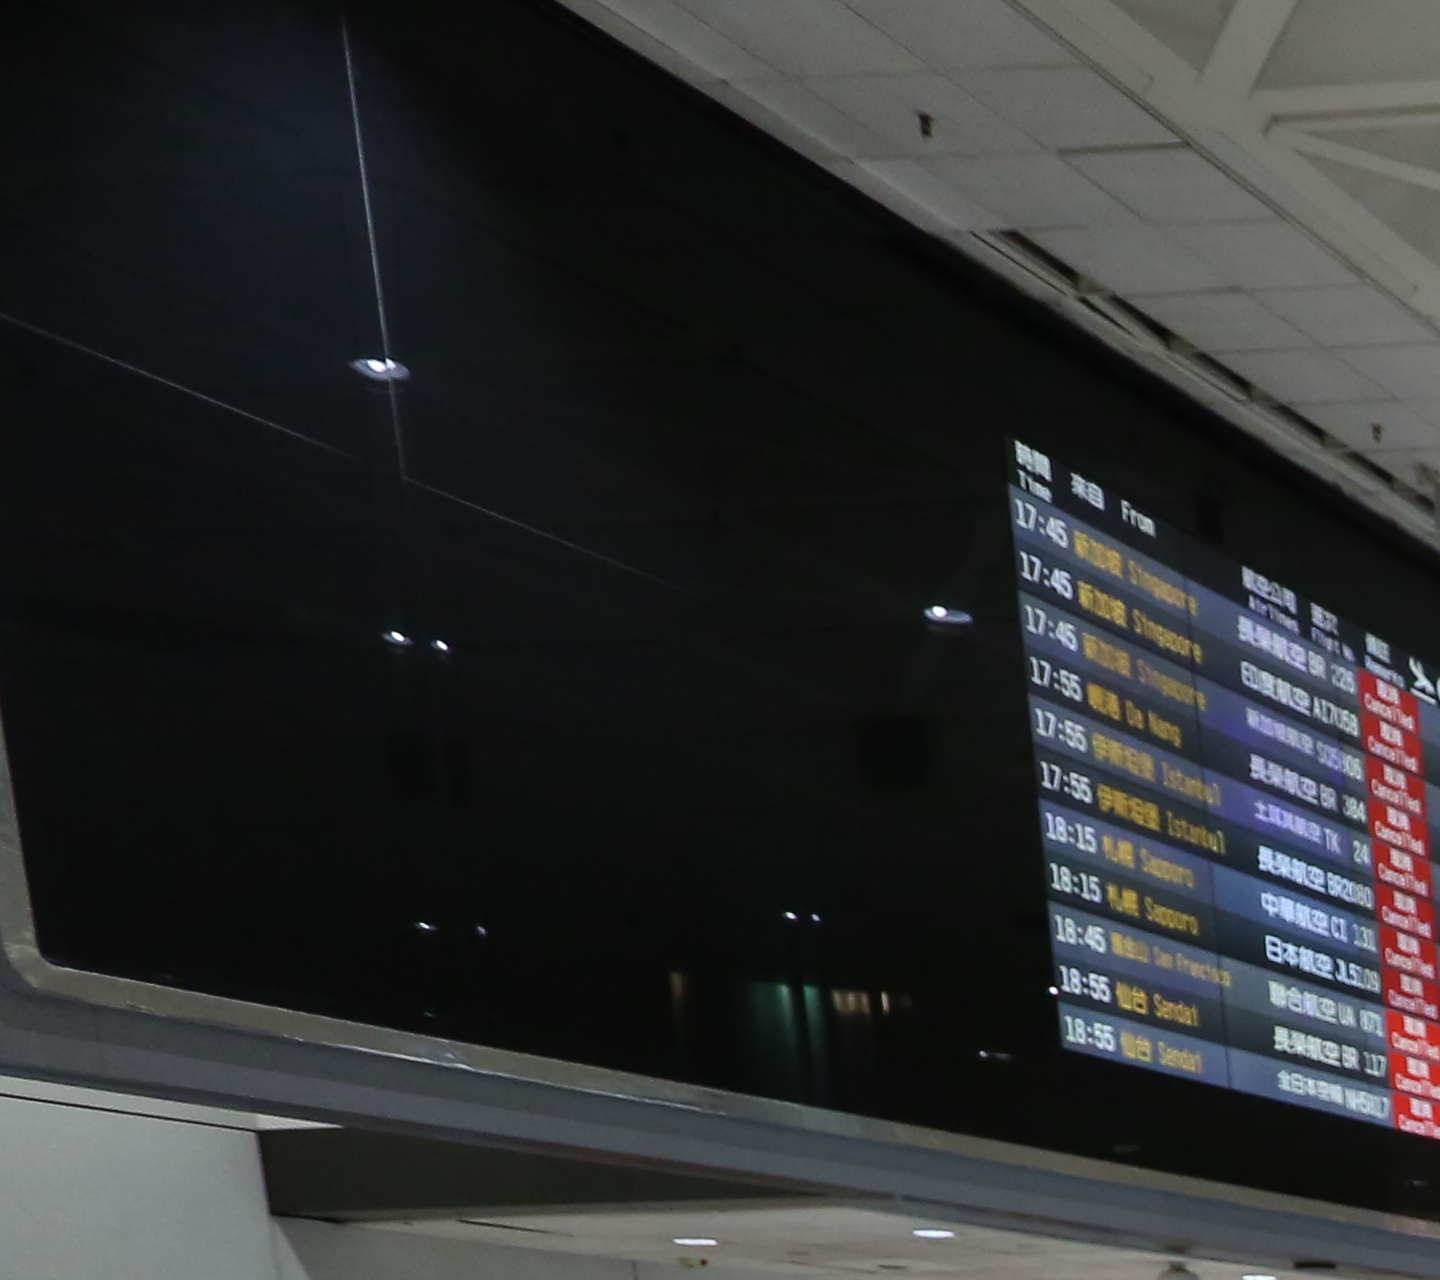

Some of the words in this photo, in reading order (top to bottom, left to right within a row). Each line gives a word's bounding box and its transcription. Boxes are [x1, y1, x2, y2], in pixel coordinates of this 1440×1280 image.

[1014, 497, 1069, 549] 17:45
[1120, 500, 1155, 537] From
[1019, 550, 1073, 600] 17:45
[1132, 609, 1202, 664] Singapore
[1024, 603, 1078, 651] 17:45
[1029, 655, 1083, 702] 17:55
[1319, 784, 1338, 813] BR
[1034, 707, 1088, 753] 17:55
[1324, 828, 1341, 856] TK
[1352, 840, 1369, 867] 24
[1039, 759, 1092, 803] 17:55
[1166, 812, 1225, 855] Istanbul
[1257, 845, 1326, 893] 長榮航空
[1044, 811, 1097, 853] 18:15
[1260, 890, 1330, 937] 中華航空
[1049, 862, 1102, 903] 18:15
[1144, 897, 1199, 937] Sapporo
[1264, 936, 1333, 980] 日本航空
[1054, 914, 1106, 953] 18:45
[1338, 1003, 1356, 1029] UA
[1059, 964, 1111, 1002] 18:55
[1153, 994, 1199, 1027] Sendai
[1272, 1026, 1340, 1067] 長榮航空
[1341, 1046, 1359, 1071] BR
[1363, 1051, 1387, 1079] 117
[1064, 1015, 1115, 1051] 18:55
